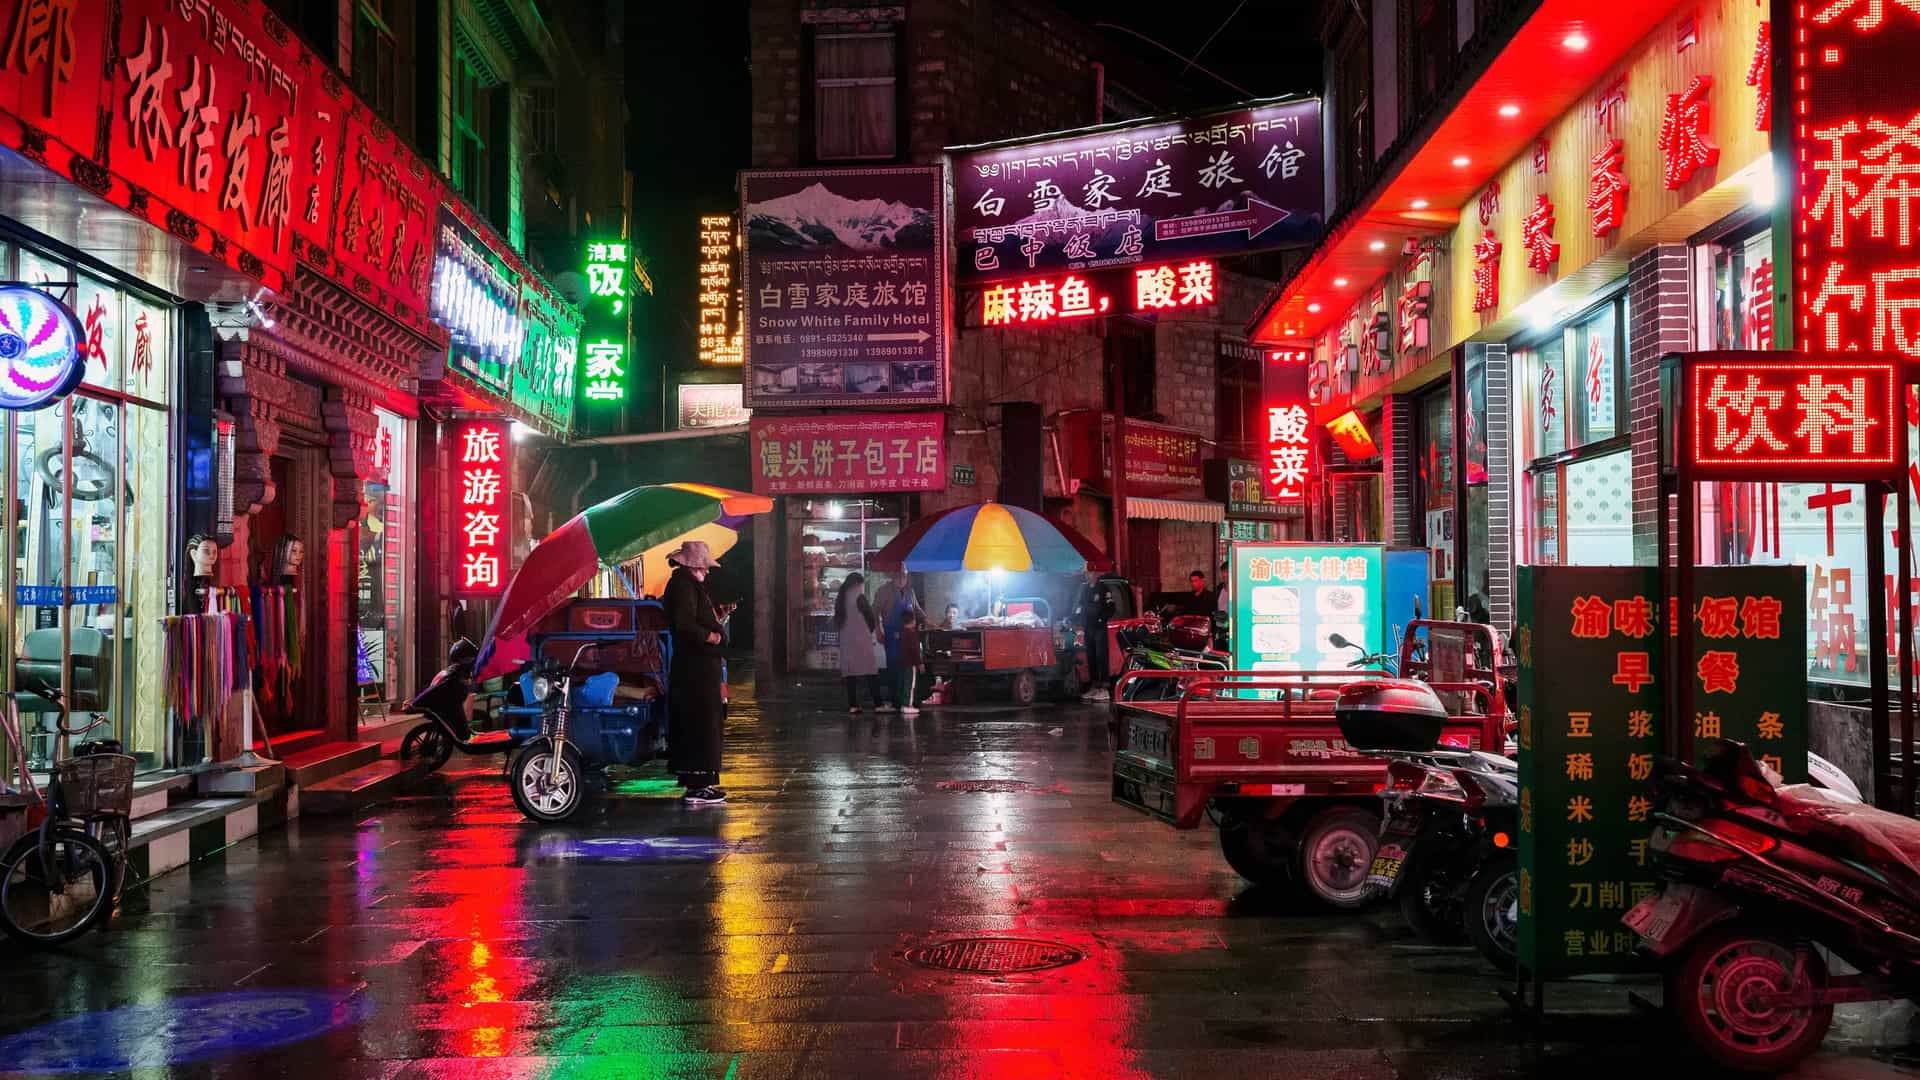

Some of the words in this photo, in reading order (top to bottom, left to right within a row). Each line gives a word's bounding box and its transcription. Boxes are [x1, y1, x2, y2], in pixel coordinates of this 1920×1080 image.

[125, 15, 293, 254] 林桔发廊
[973, 141, 1306, 217] 白雪家庭旅馆
[975, 225, 1144, 272] 巴中饭店
[759, 280, 928, 309] 白雪家庭旅馆
[1136, 262, 1214, 309] 酸菜
[759, 316, 797, 328] Snow
[801, 315, 841, 328] White
[844, 313, 890, 329] Family
[893, 312, 930, 325] Hotel
[1705, 374, 1878, 454] 饮料
[760, 435, 938, 478] 馒头饼子包子店
[1268, 404, 1309, 497] 酸菜
[463, 428, 501, 587] 旅游咨询
[1250, 556, 1368, 581] 渝味大排档
[1612, 650, 1740, 695] 早餐
[1566, 710, 1654, 738] 豆浆
[1694, 710, 1784, 740] 油条
[1566, 753, 1654, 783] 稀饭
[1566, 838, 1649, 866] 抄手
[1567, 880, 1656, 910] 刀削面
